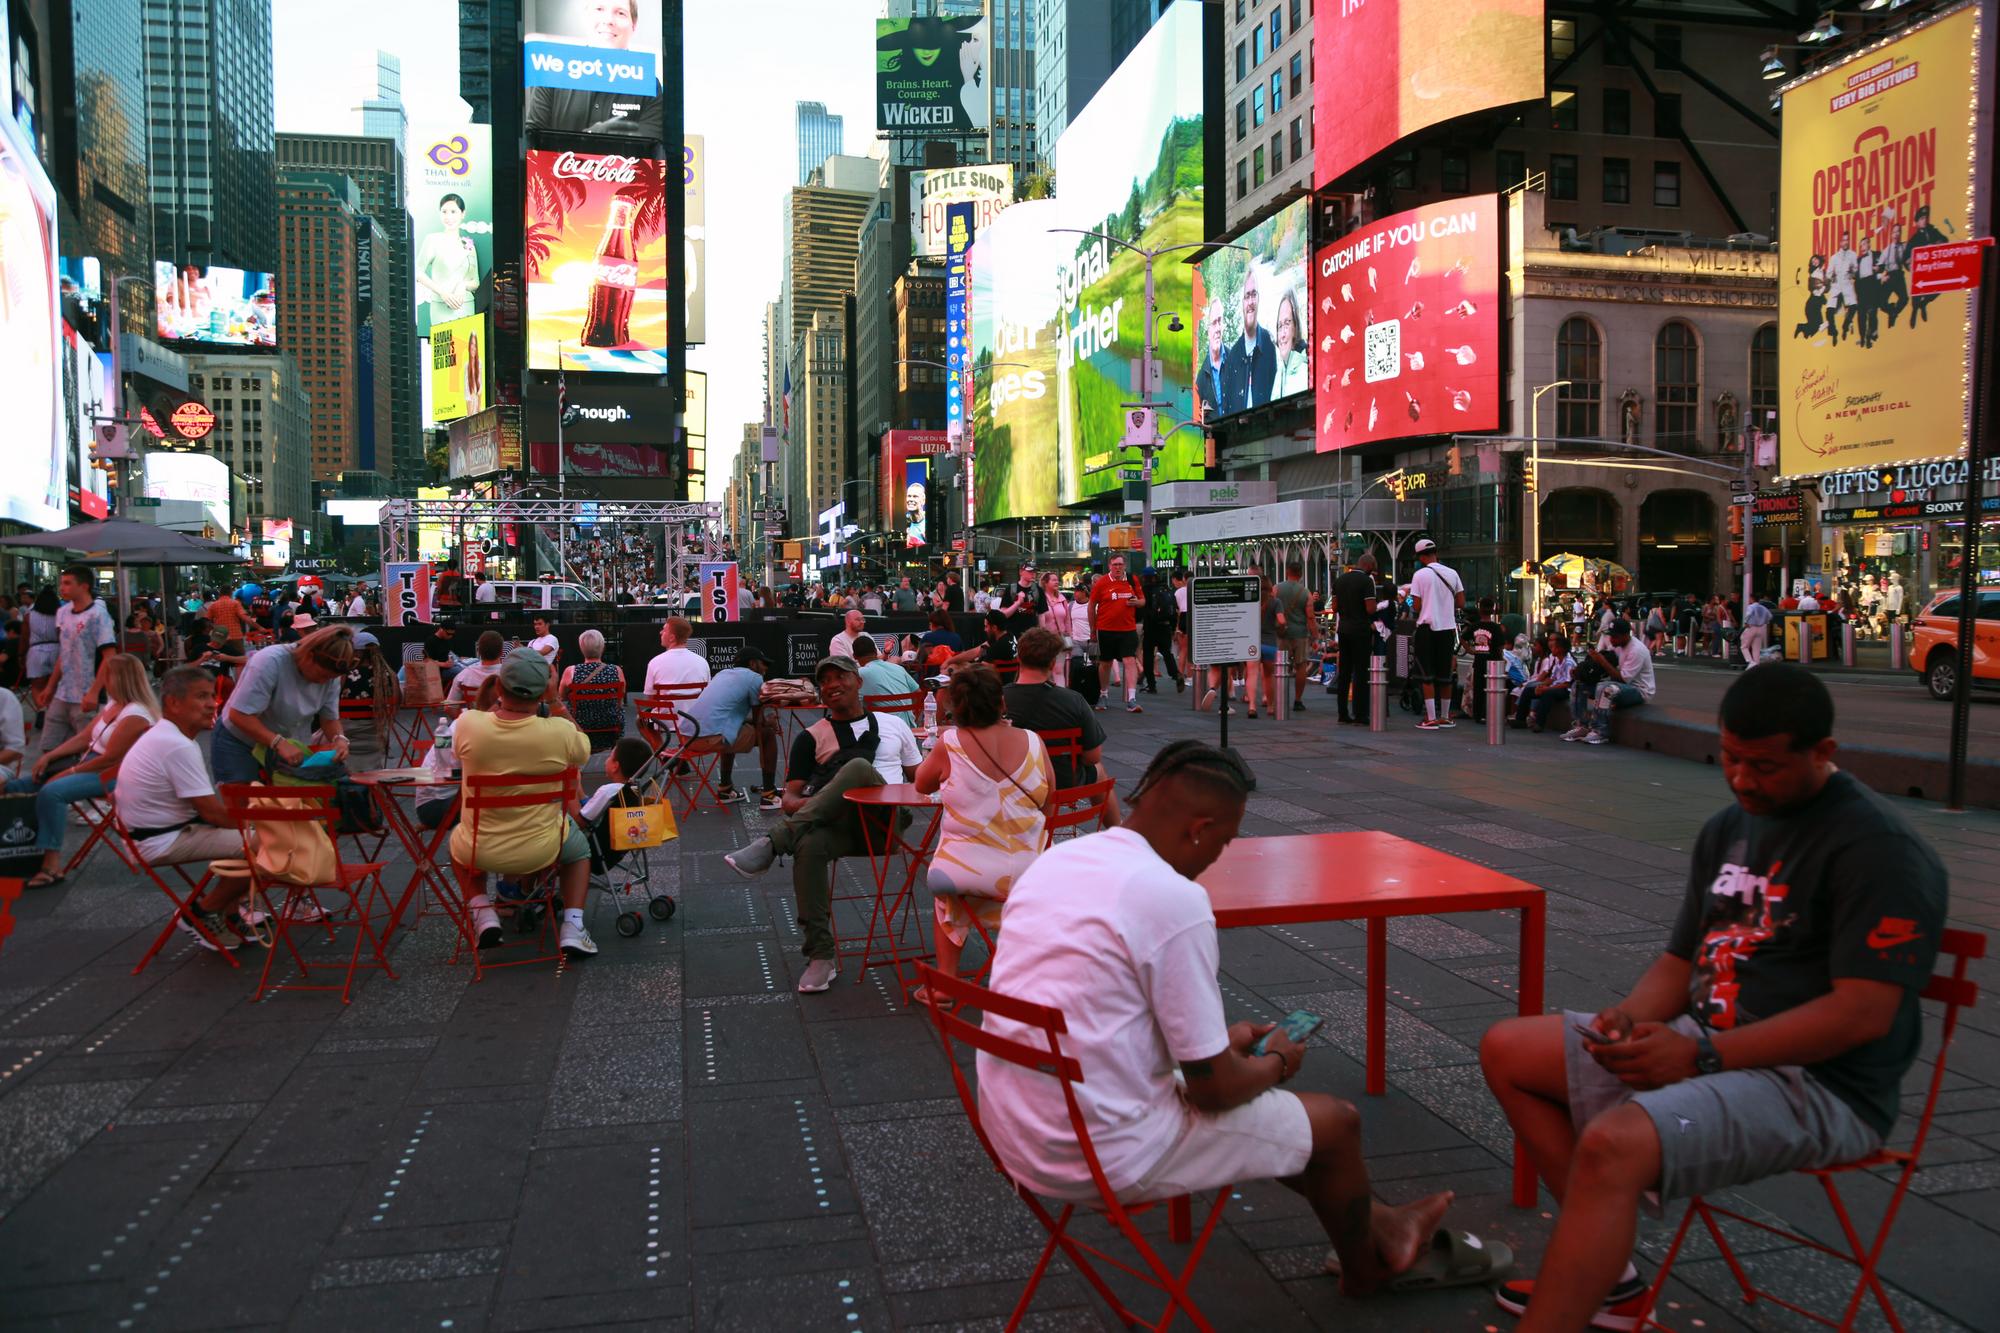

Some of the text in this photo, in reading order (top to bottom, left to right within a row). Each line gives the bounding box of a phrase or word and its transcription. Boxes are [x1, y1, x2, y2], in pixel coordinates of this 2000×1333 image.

[531, 53, 644, 83] We got you
[886, 79, 952, 89] Brains. Heart.
[1831, 90, 1857, 110] VERY
[1857, 82, 1876, 99] BIG
[1876, 64, 1916, 92] FUTURE
[897, 90, 940, 100] Courage.
[424, 168, 447, 176] THAI
[552, 151, 640, 183] Coca-Cola
[1812, 127, 1936, 217] OPERATION
[920, 171, 1004, 200] LITTLE SHOP
[1322, 211, 1477, 278] CATCH ME IF YOU CAN
[1915, 244, 1979, 261] NO STOPPING
[1688, 253, 1766, 272] MILLER
[1915, 260, 1955, 273] Anytime
[1671, 288, 1706, 303] SHOE
[1712, 290, 1746, 305] SHOP
[183, 404, 201, 413] HOT
[571, 404, 631, 422] nough.
[1835, 409, 1859, 419] NEW
[1861, 401, 1911, 415] MUSICAL
[183, 426, 204, 435] NOW
[1129, 471, 1137, 479] 46
[1822, 470, 1879, 496] GIFTS
[1752, 496, 1799, 511] TRONICS
[1905, 489, 1927, 502] NY
[1767, 513, 1799, 523] LUGGAGE
[1831, 512, 1847, 521] Apple
[1853, 508, 1879, 519] Nikon
[1883, 505, 1920, 518] Canon
[1925, 502, 1964, 513] SONY
[295, 559, 338, 568] KLIKTIX
[466, 543, 481, 572] tkts
[1156, 559, 1175, 568] SOCCER
[712, 646, 738, 654] TIMES
[709, 655, 736, 663] SQUAR
